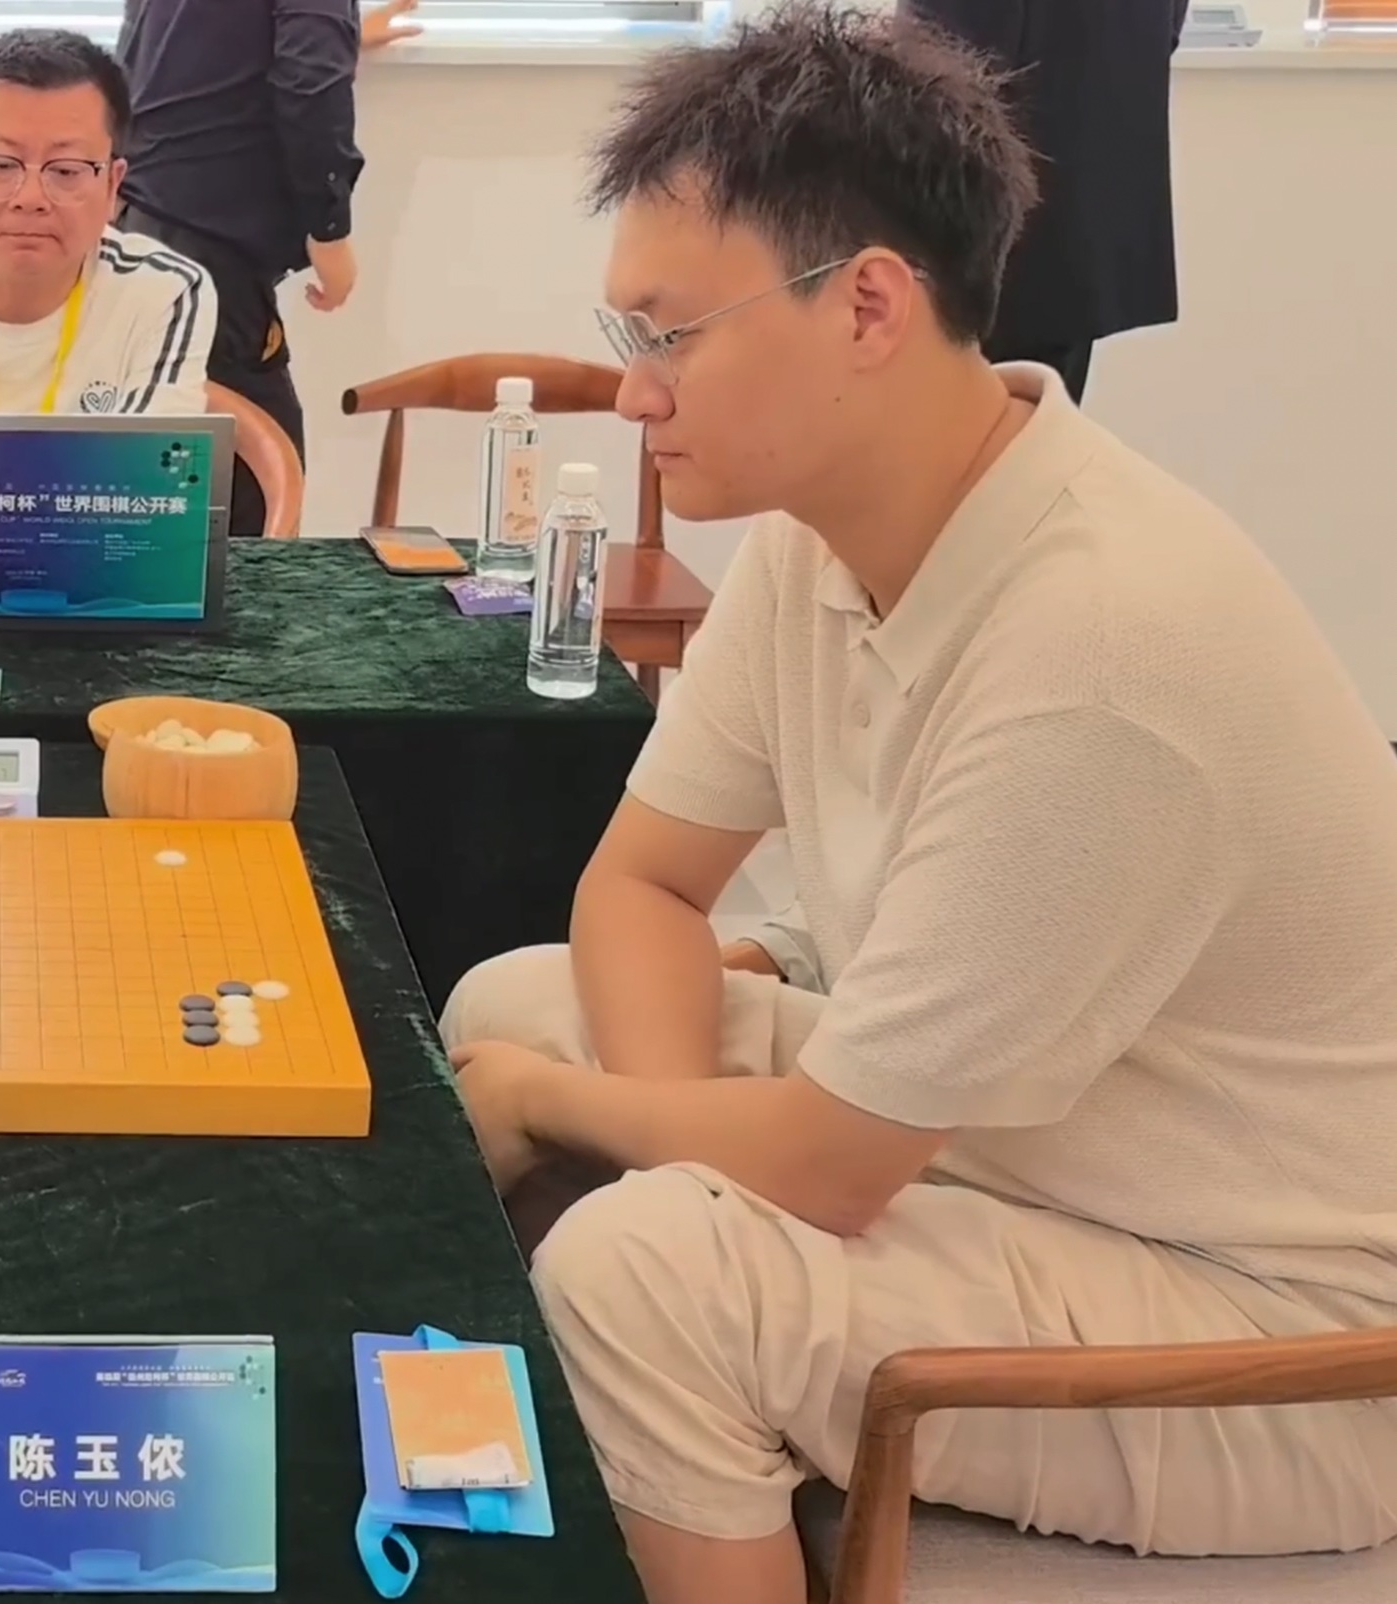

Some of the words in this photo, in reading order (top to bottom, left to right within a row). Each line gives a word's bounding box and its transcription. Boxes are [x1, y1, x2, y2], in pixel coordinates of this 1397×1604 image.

[8, 1432, 187, 1482] 陈玉侬
[19, 1489, 77, 1508] CHEN
[83, 1489, 109, 1508] YU
[115, 1489, 176, 1508] NONG
